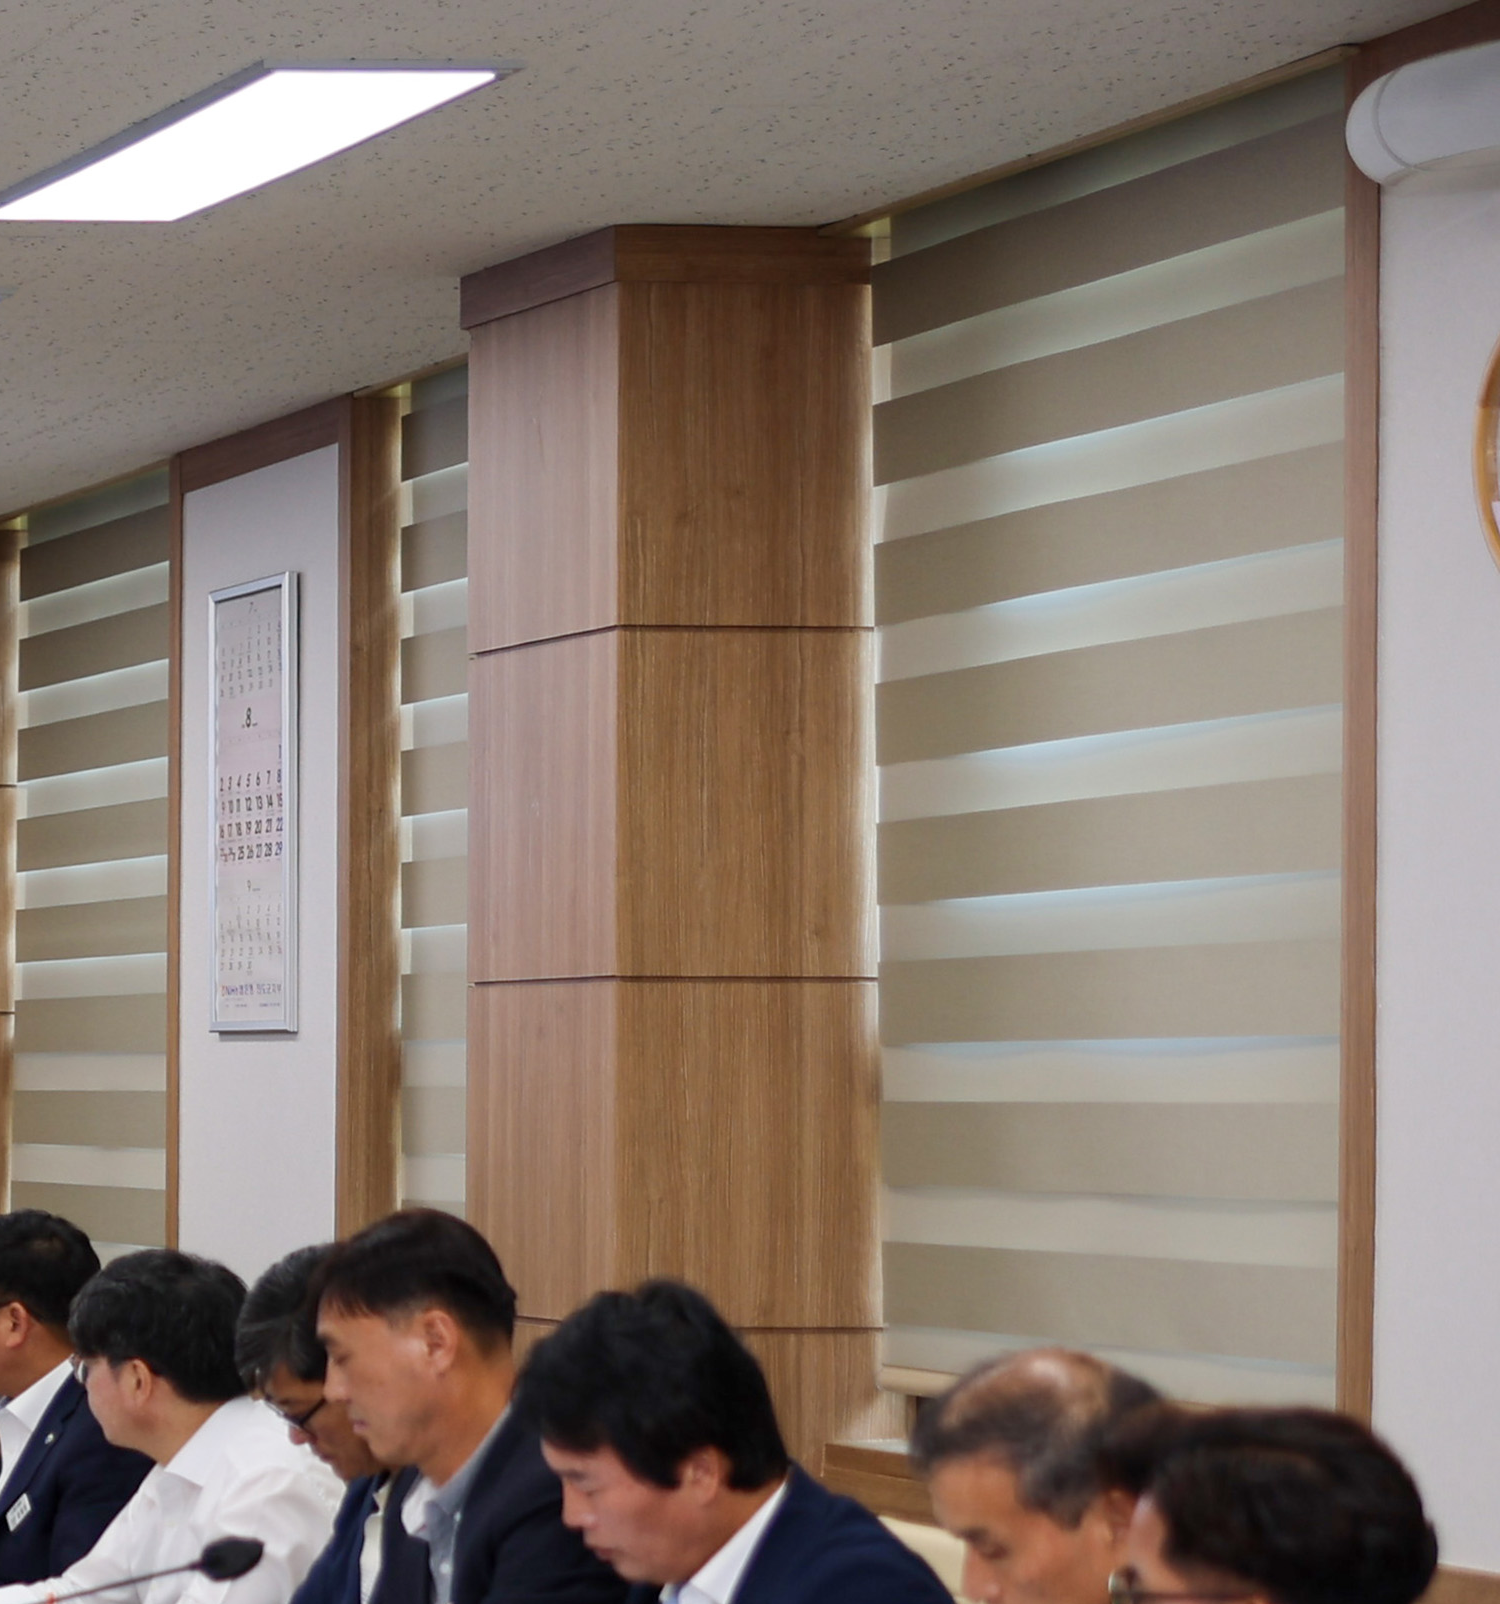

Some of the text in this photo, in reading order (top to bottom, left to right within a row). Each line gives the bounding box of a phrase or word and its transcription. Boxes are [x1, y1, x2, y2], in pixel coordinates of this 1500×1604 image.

[246, 707, 251, 728] 8
[246, 773, 251, 787] 5
[256, 772, 260, 786] 6
[267, 770, 270, 785] 7
[245, 797, 252, 811] 12
